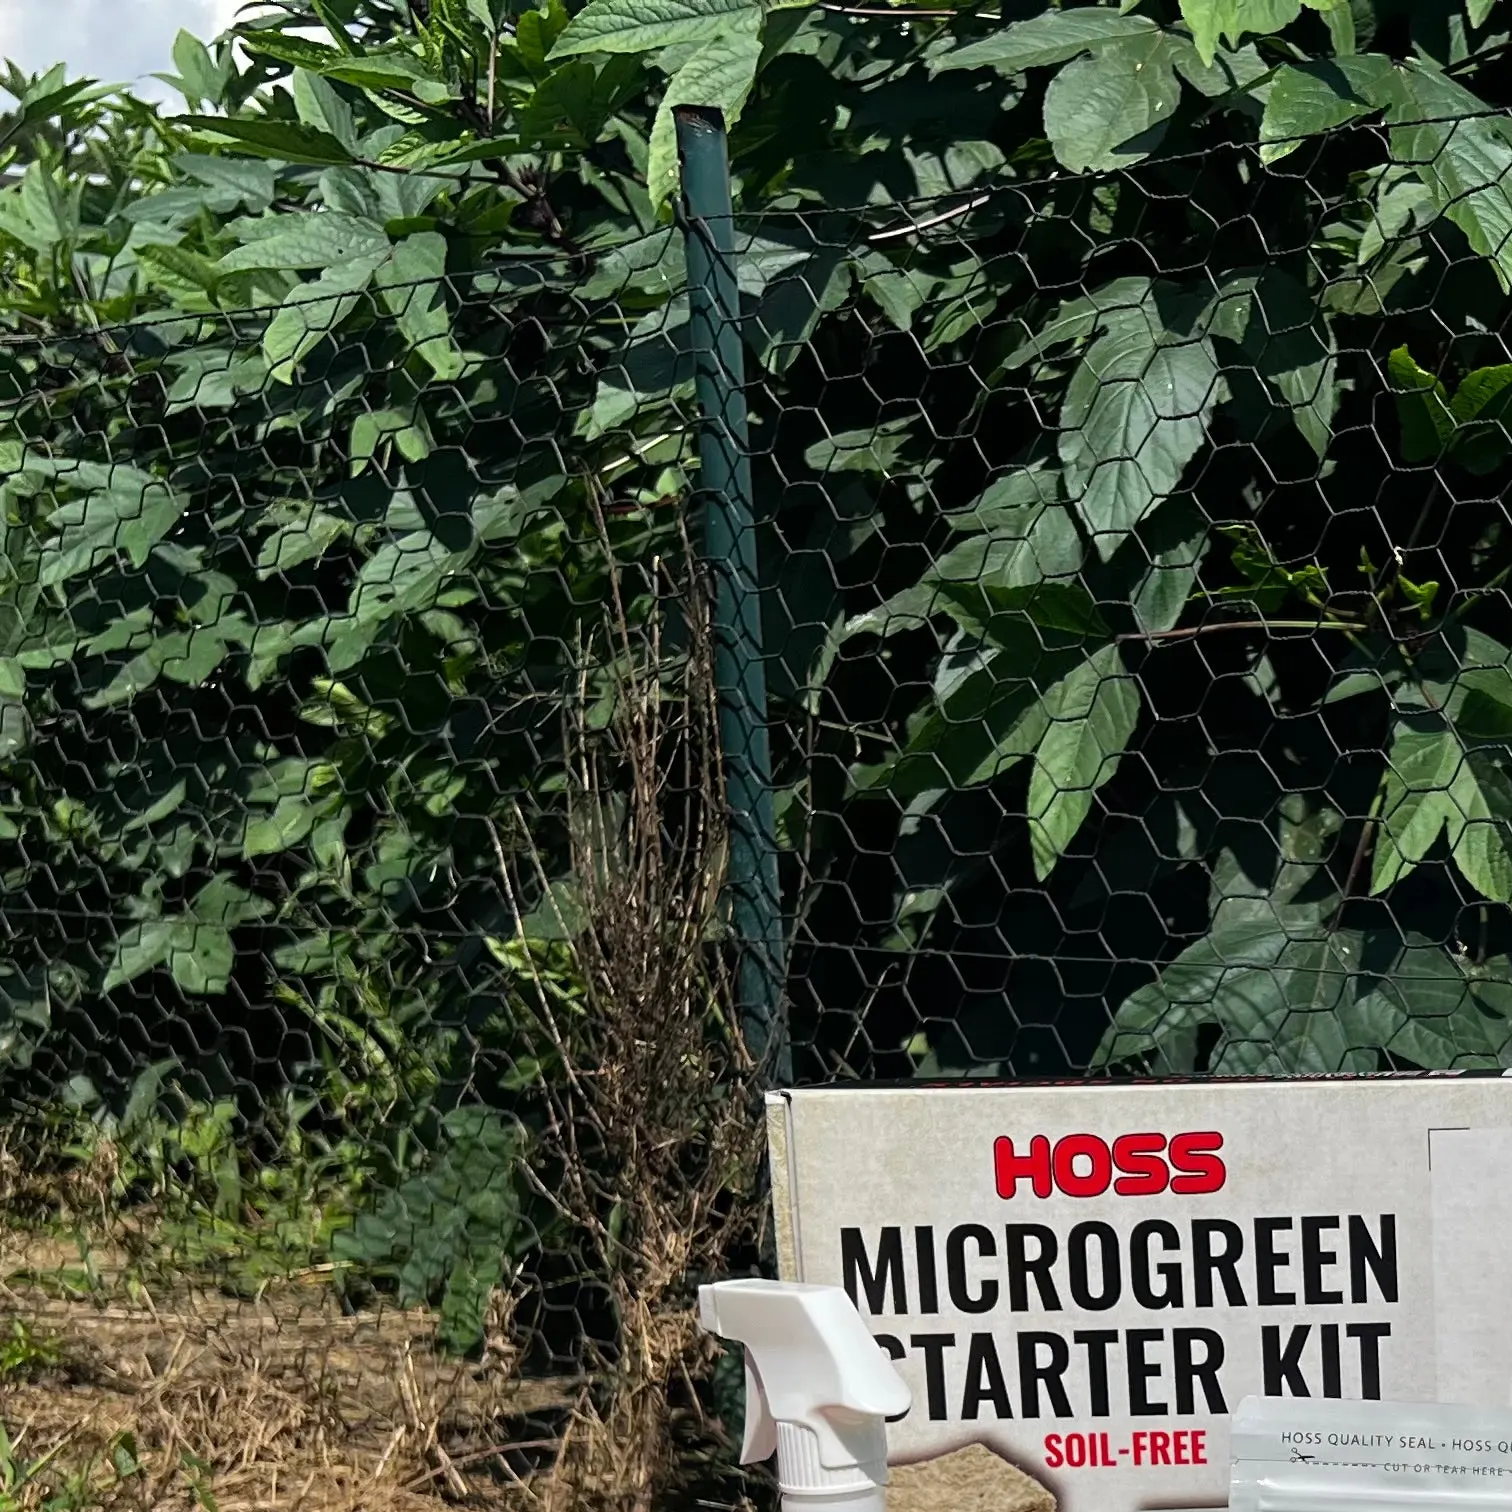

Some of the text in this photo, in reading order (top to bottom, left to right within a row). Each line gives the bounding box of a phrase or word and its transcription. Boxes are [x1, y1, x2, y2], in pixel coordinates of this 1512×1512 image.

[993, 1131, 1226, 1199] HOSS
[840, 1213, 1399, 1316] MICROGREEN
[1261, 1322, 1391, 1400] KIT
[1044, 1431, 1207, 1468] SOIL-FREE
[1282, 1432, 1322, 1446] HOSS
[1327, 1432, 1394, 1450] QUALITY
[1399, 1436, 1435, 1450] SEAL
[1452, 1439, 1493, 1452] HOSS
[1383, 1462, 1503, 1476] CUT TEAR HERE
